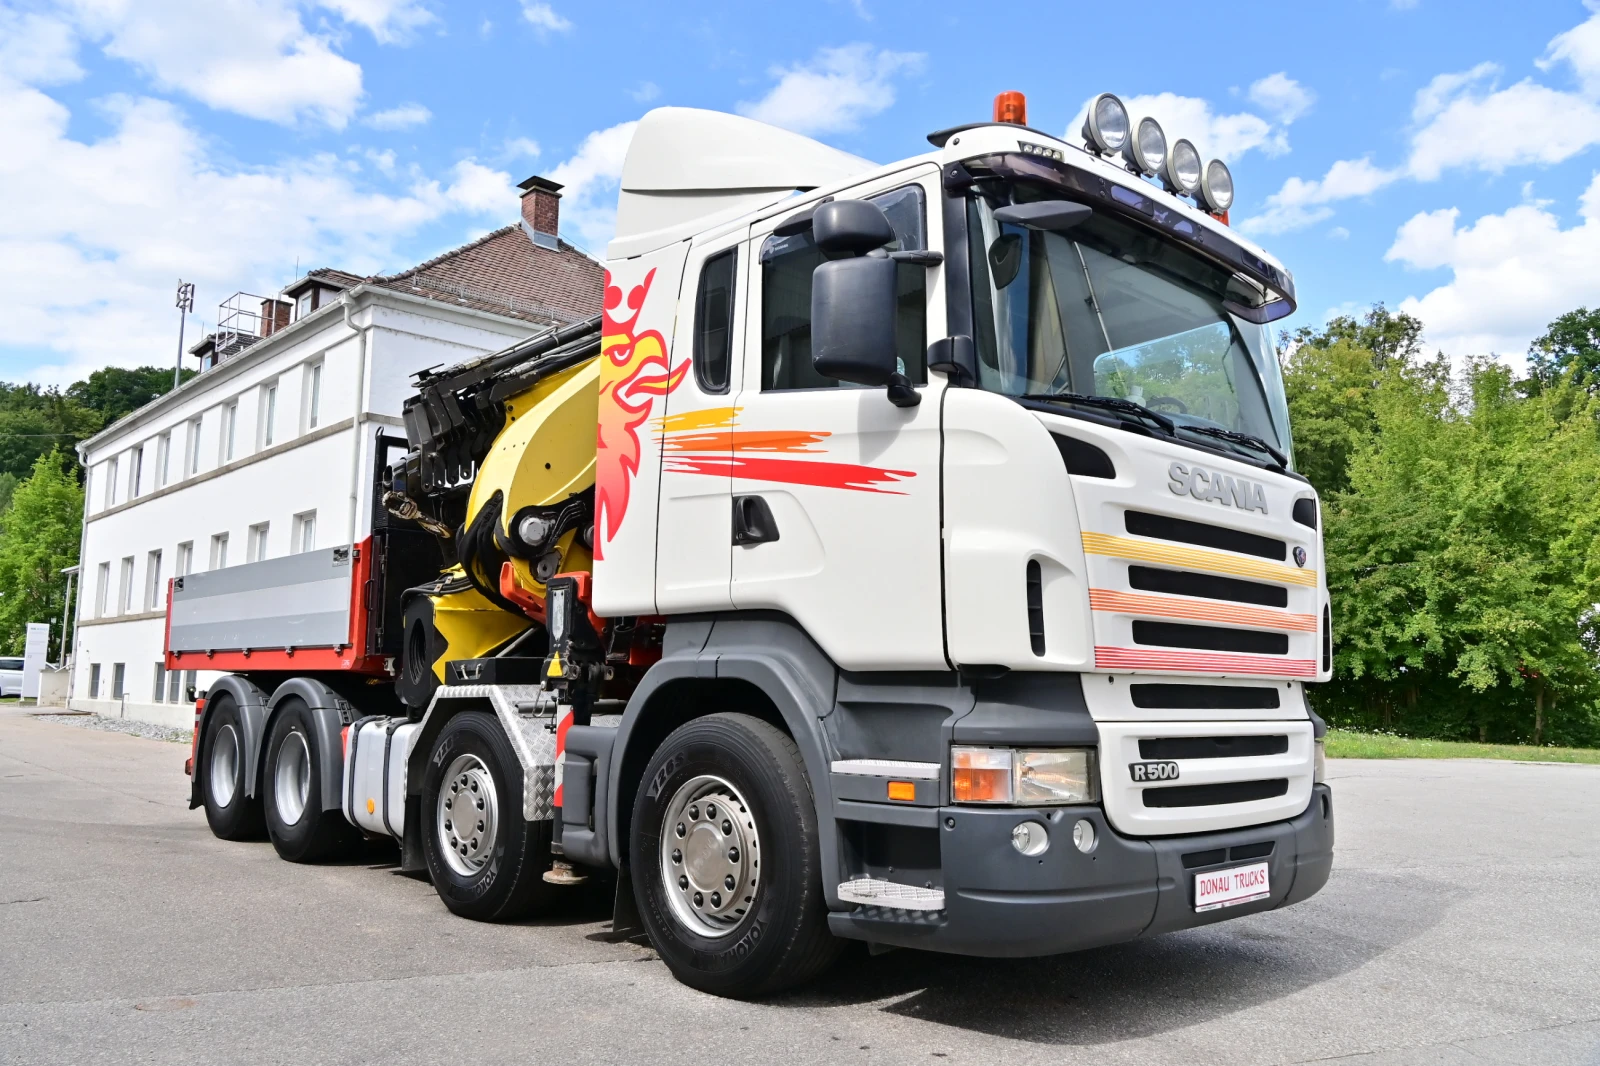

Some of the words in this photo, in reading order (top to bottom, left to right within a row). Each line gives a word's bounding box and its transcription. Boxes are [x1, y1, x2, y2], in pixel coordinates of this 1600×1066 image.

[1168, 462, 1268, 514] SCANIA
[1200, 876, 1230, 896] DONAU
[1234, 869, 1265, 889] TRUCKS
